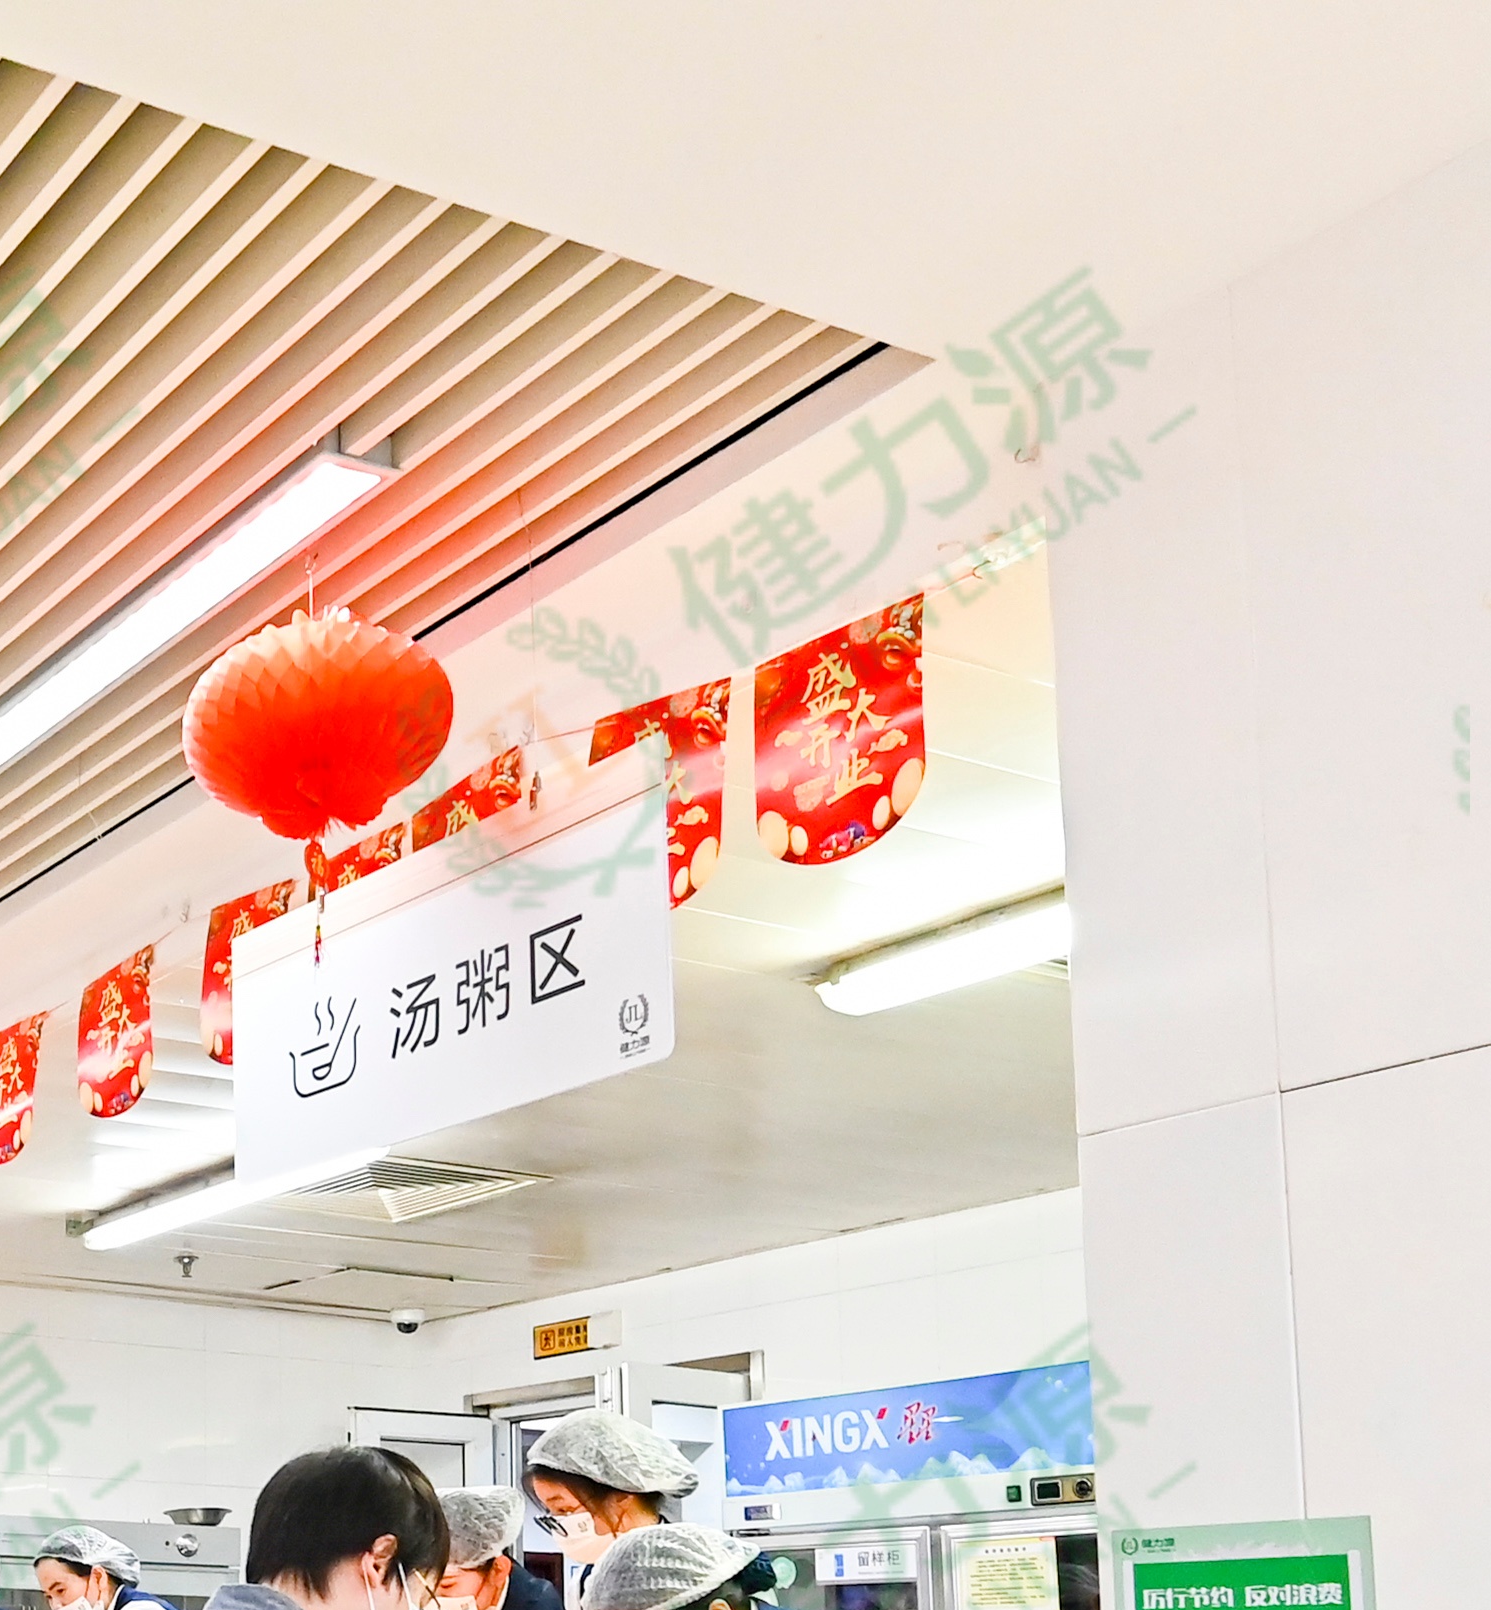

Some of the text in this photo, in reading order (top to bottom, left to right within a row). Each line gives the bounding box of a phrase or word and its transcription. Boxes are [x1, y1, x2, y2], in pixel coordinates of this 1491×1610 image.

[390, 913, 585, 1059] 汤粥区
[625, 1004, 643, 1024] JL
[765, 1406, 890, 1462] XINGX
[857, 1550, 901, 1568] 留样柜
[1142, 1583, 1344, 1610] 厉行节约 反对浪费
